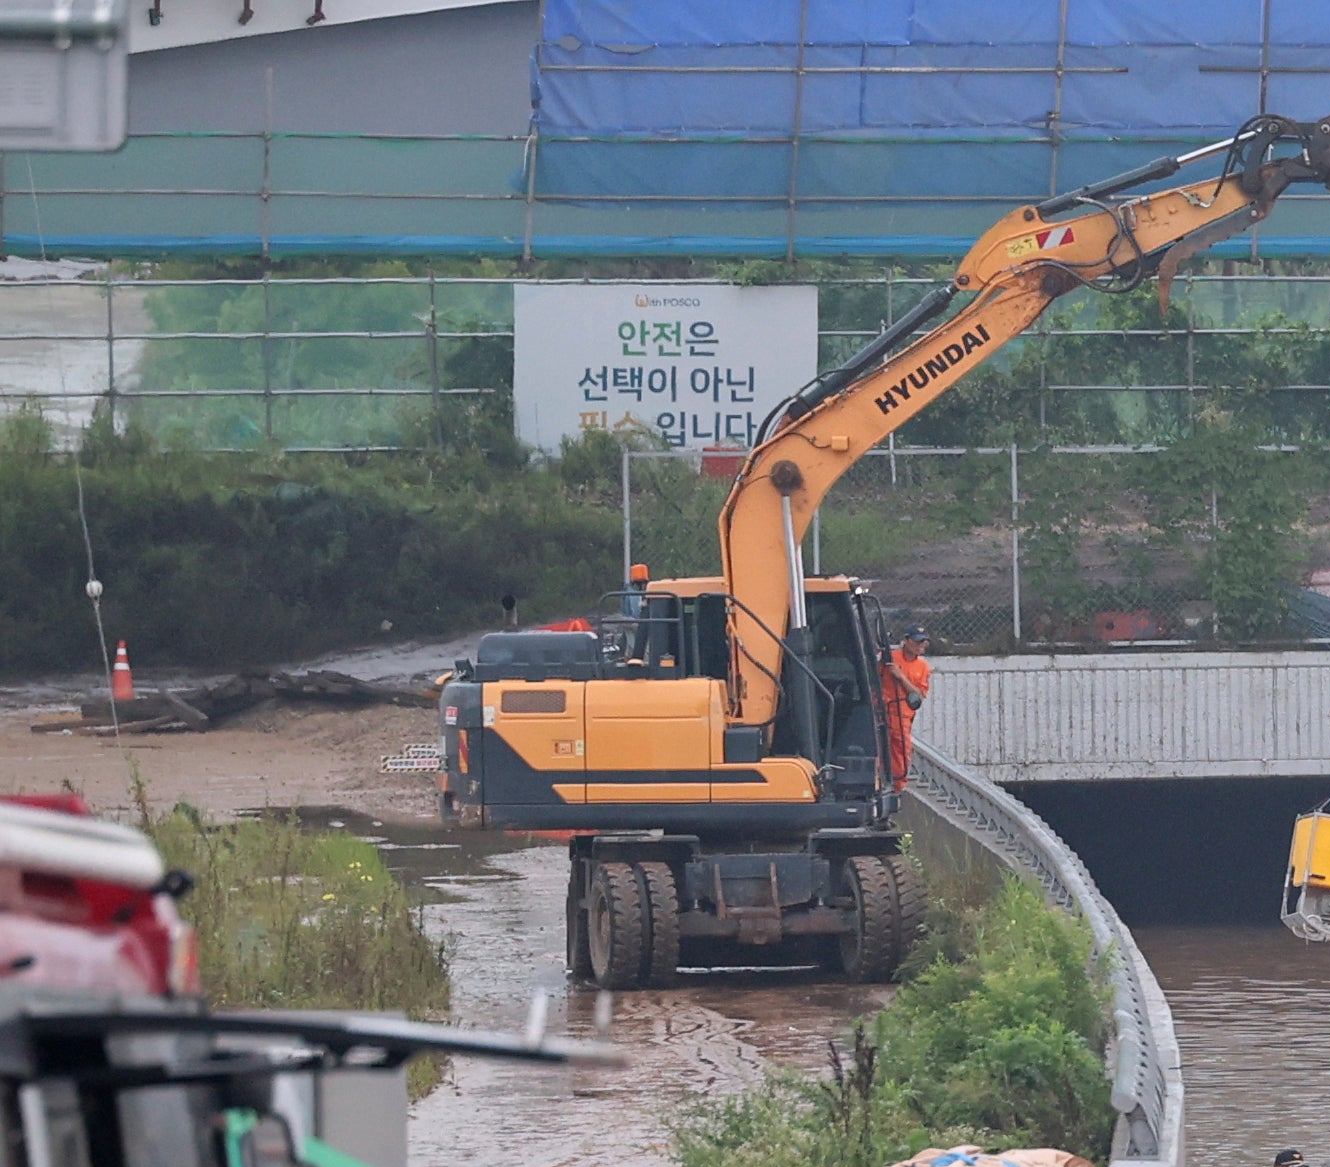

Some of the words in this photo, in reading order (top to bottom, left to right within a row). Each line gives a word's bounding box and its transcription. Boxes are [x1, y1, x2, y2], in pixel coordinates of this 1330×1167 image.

[618, 320, 719, 357] 안전은
[578, 365, 677, 402] 선택이
[690, 366, 755, 402] 아닌
[874, 323, 991, 415] HYUNDAI
[656, 411, 757, 447] 입니다
